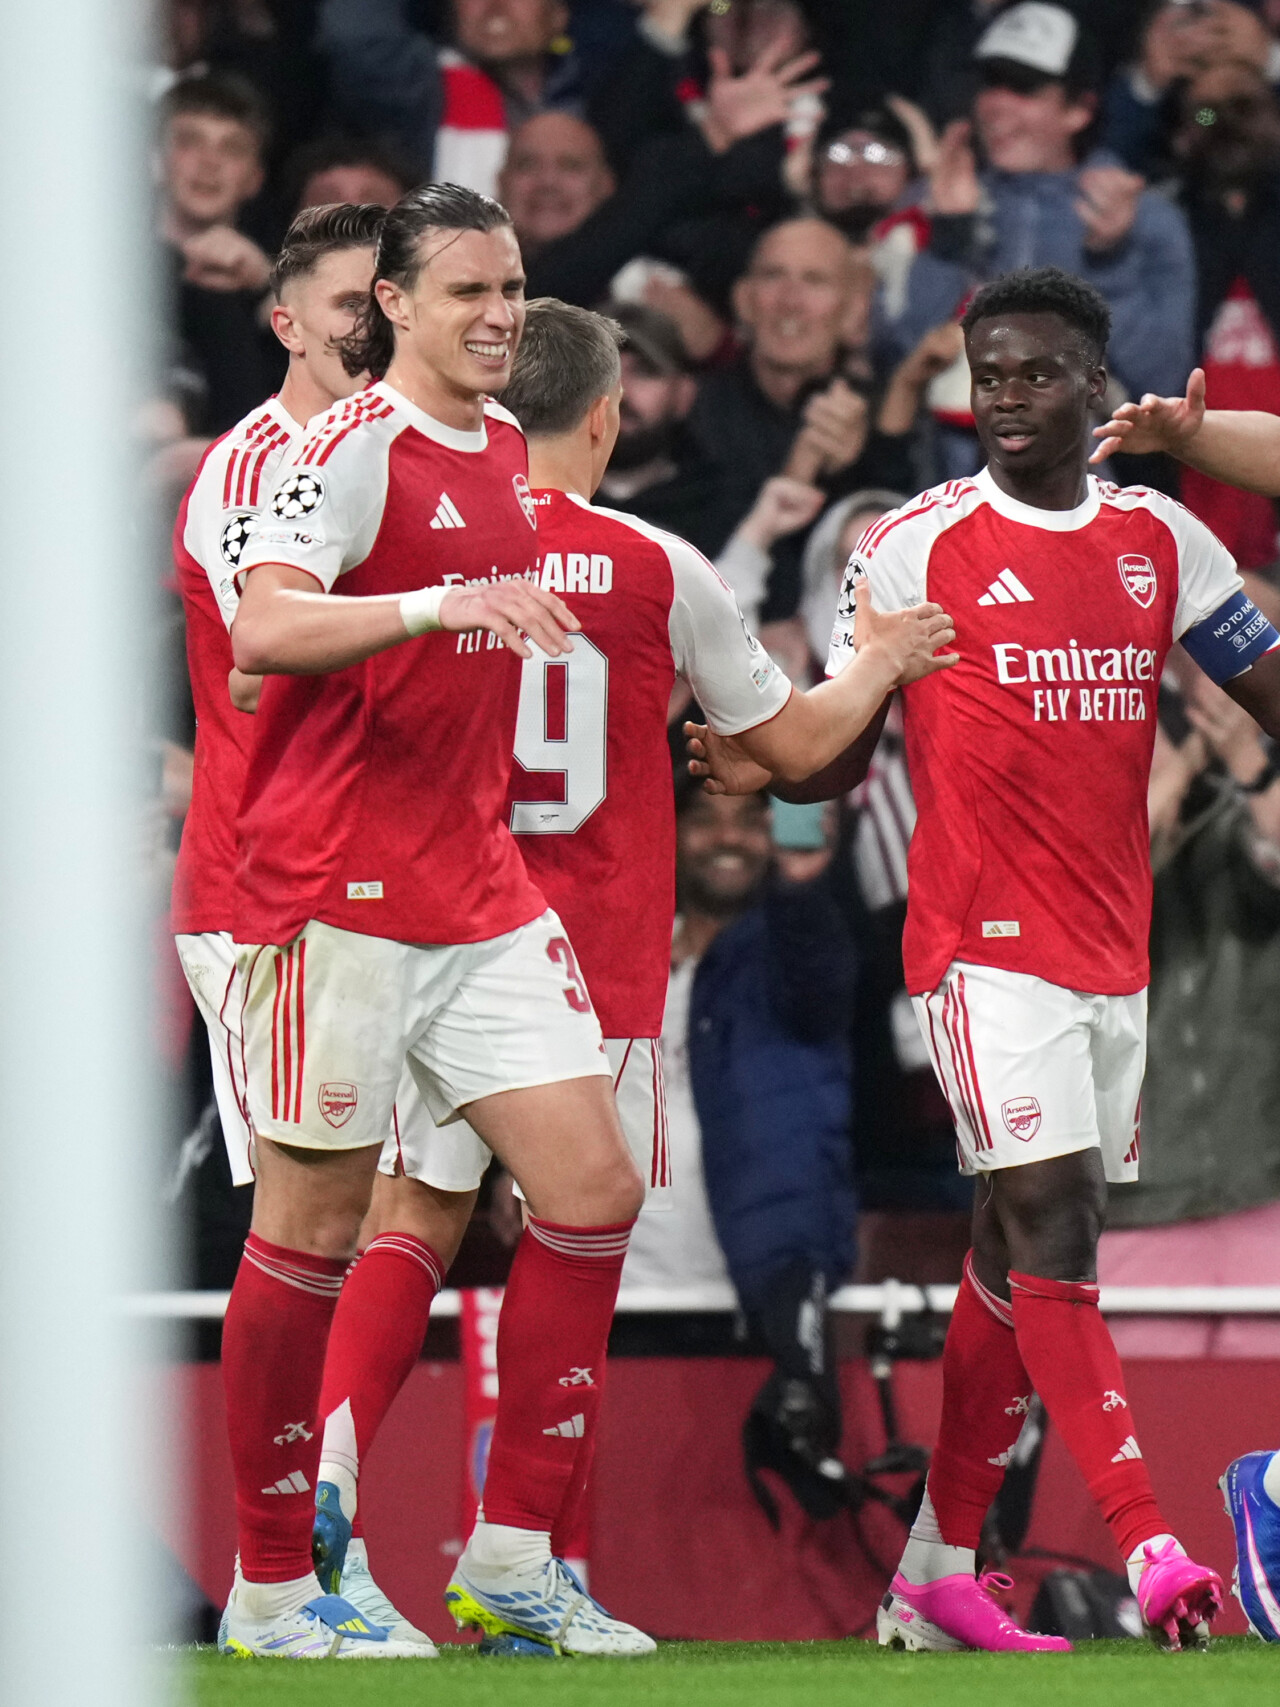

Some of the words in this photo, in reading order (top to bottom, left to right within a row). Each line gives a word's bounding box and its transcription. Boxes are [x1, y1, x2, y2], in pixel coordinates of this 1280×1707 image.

[537, 552, 613, 594] ARD
[1213, 622, 1231, 639] NO
[1228, 611, 1244, 625] TO
[1033, 688, 1071, 722] FLY
[323, 1090, 353, 1098] Arsenal
[1006, 1103, 1036, 1115] Arsenal
